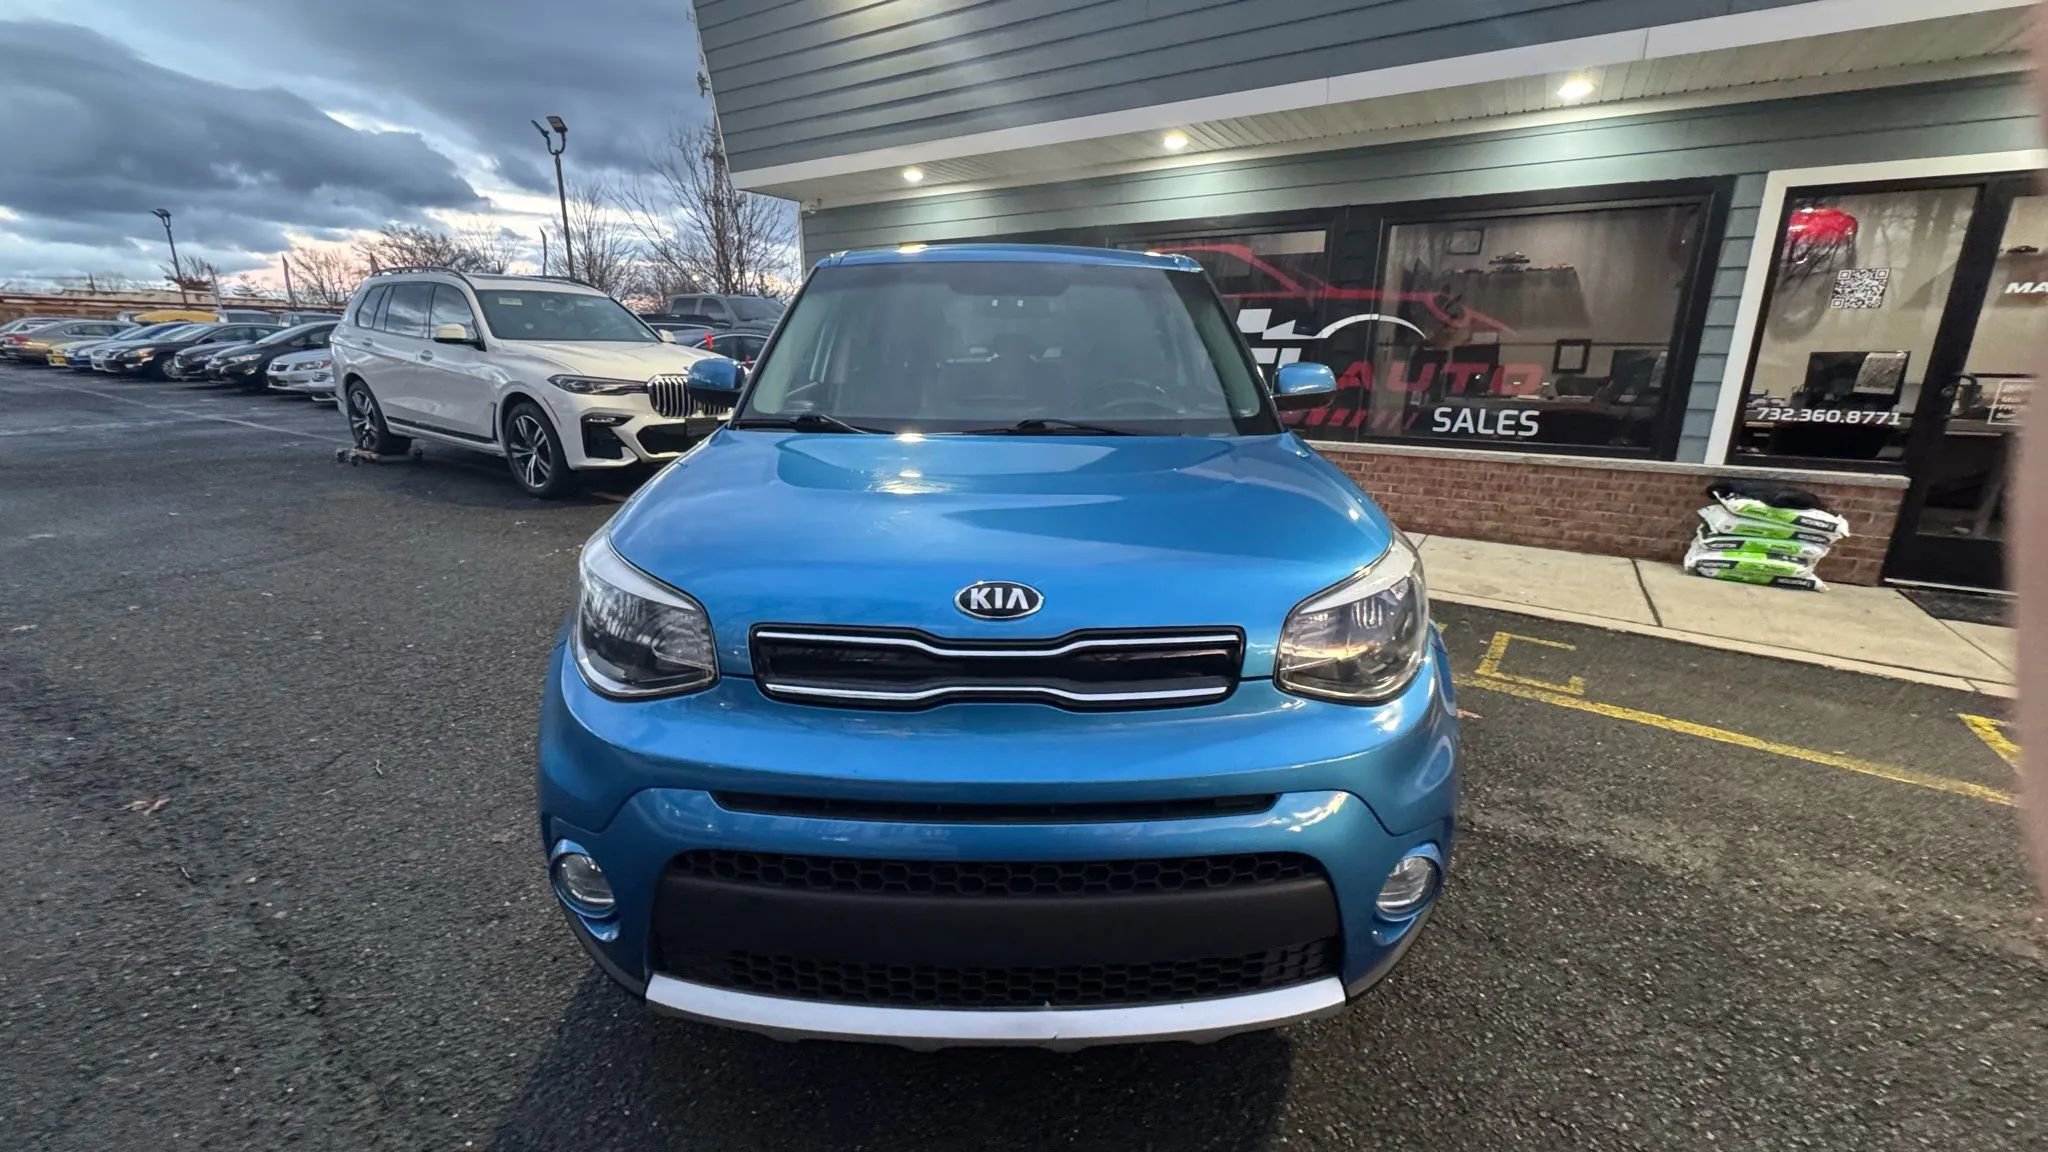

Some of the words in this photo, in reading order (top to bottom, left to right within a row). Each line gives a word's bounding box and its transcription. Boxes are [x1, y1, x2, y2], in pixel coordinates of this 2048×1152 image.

[1337, 360, 1545, 396] AUTO
[1432, 407, 1540, 437] SALES
[1757, 407, 1901, 426] 732.360.8771
[970, 587, 1029, 609] KIA
